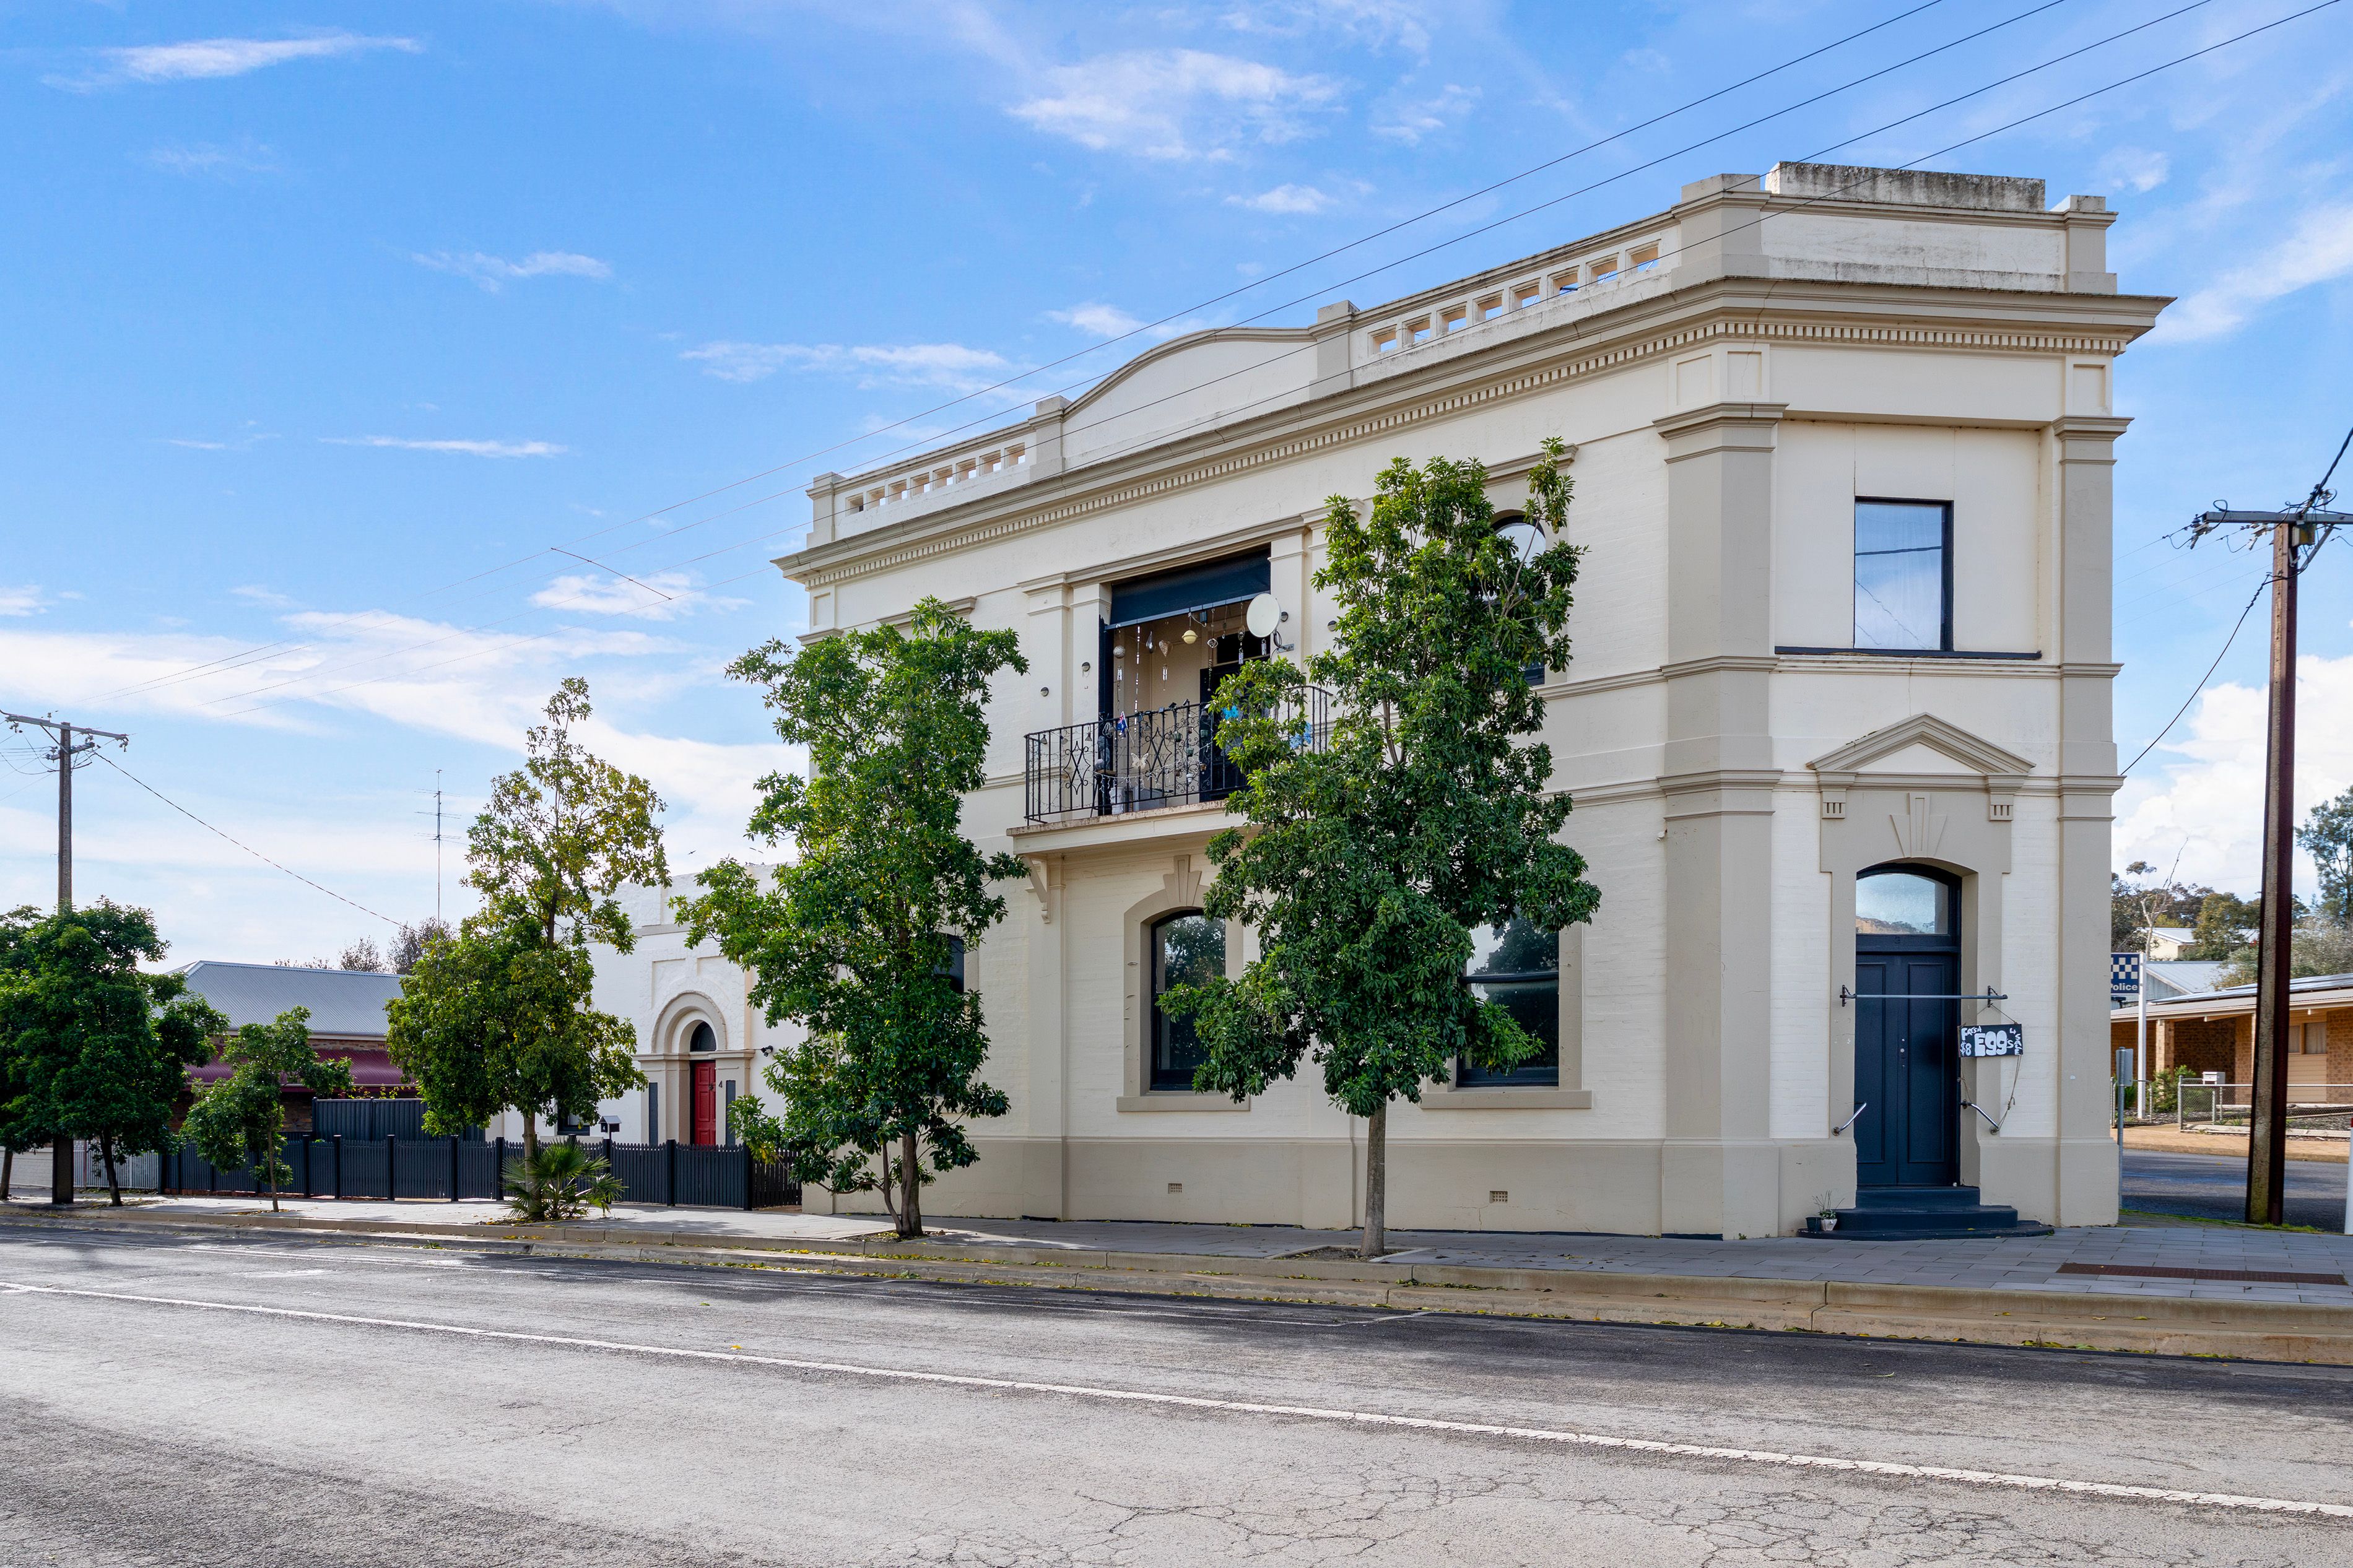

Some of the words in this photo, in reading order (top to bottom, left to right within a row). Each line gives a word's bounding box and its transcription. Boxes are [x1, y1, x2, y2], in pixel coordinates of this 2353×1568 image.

[1961, 1026, 1981, 1041] FRESH
[1960, 1041, 1972, 1056] $8
[2014, 1033, 2022, 1055] SALE
[718, 1080, 723, 1088] 4
